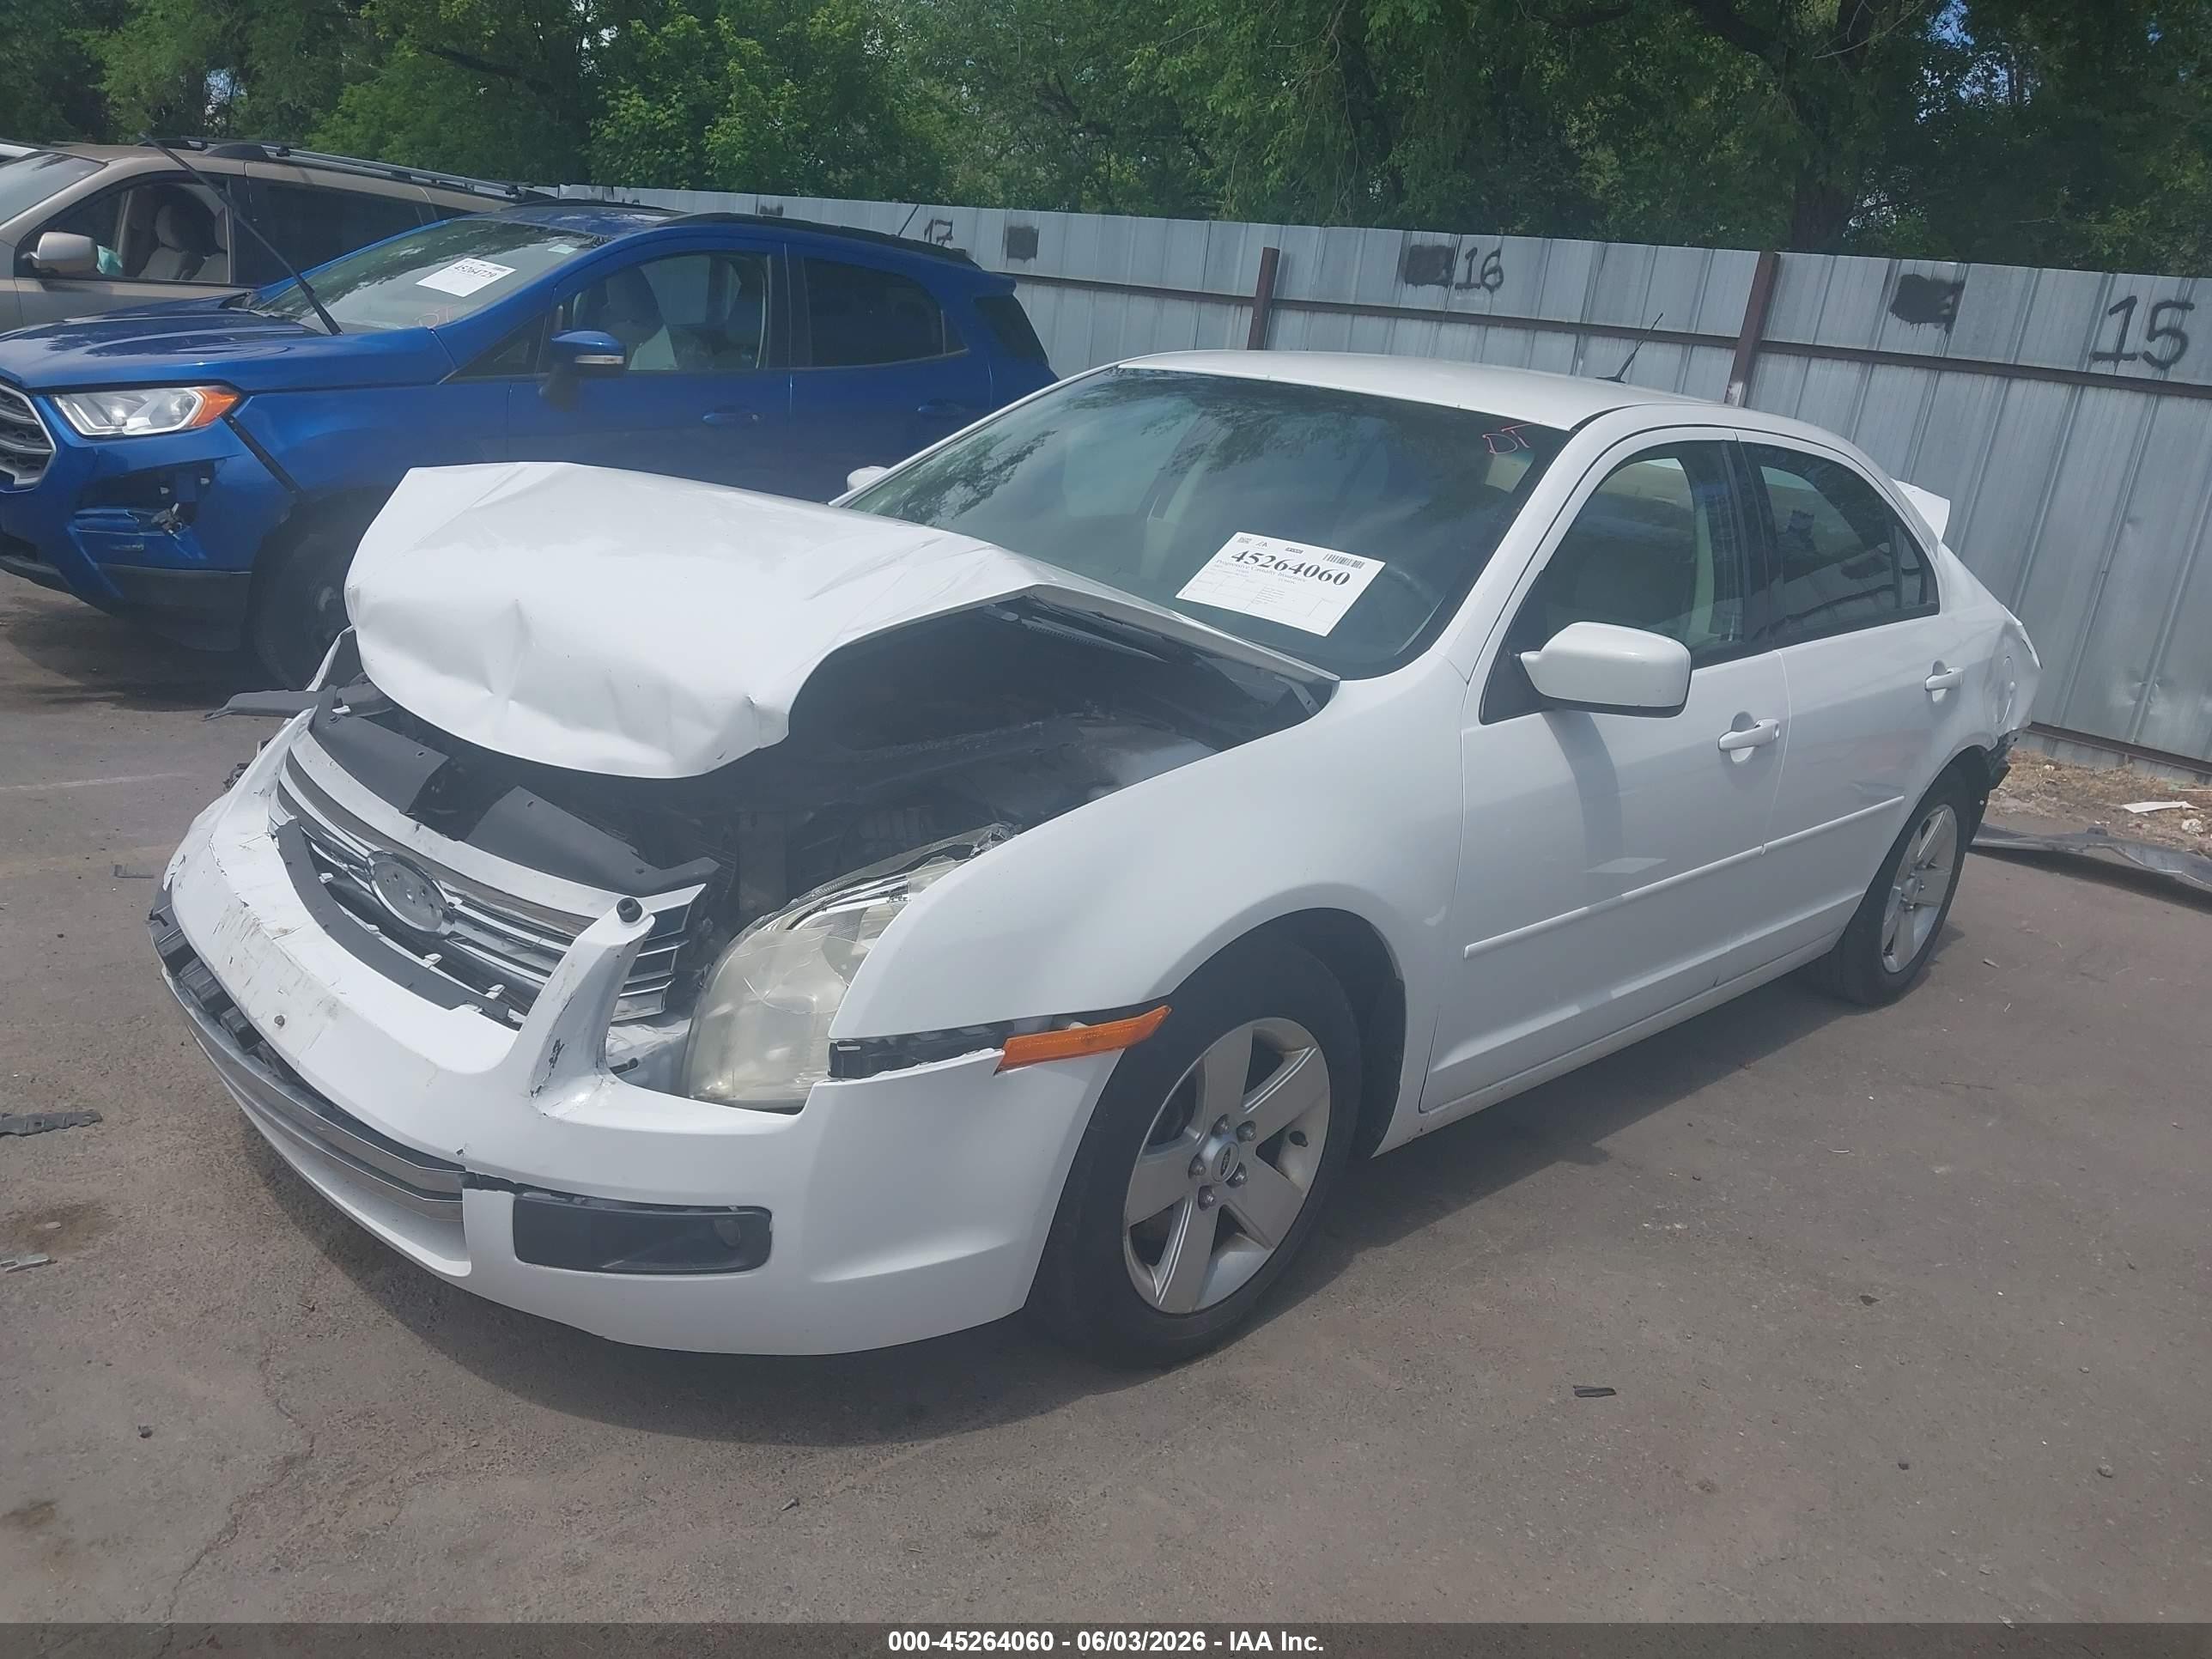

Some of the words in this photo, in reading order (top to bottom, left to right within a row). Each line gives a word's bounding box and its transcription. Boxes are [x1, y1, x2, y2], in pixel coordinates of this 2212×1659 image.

[1455, 247, 1504, 293] 16
[2089, 295, 2196, 370] 15
[1482, 422, 1535, 454] DT
[1231, 550, 1351, 586] 45264060
